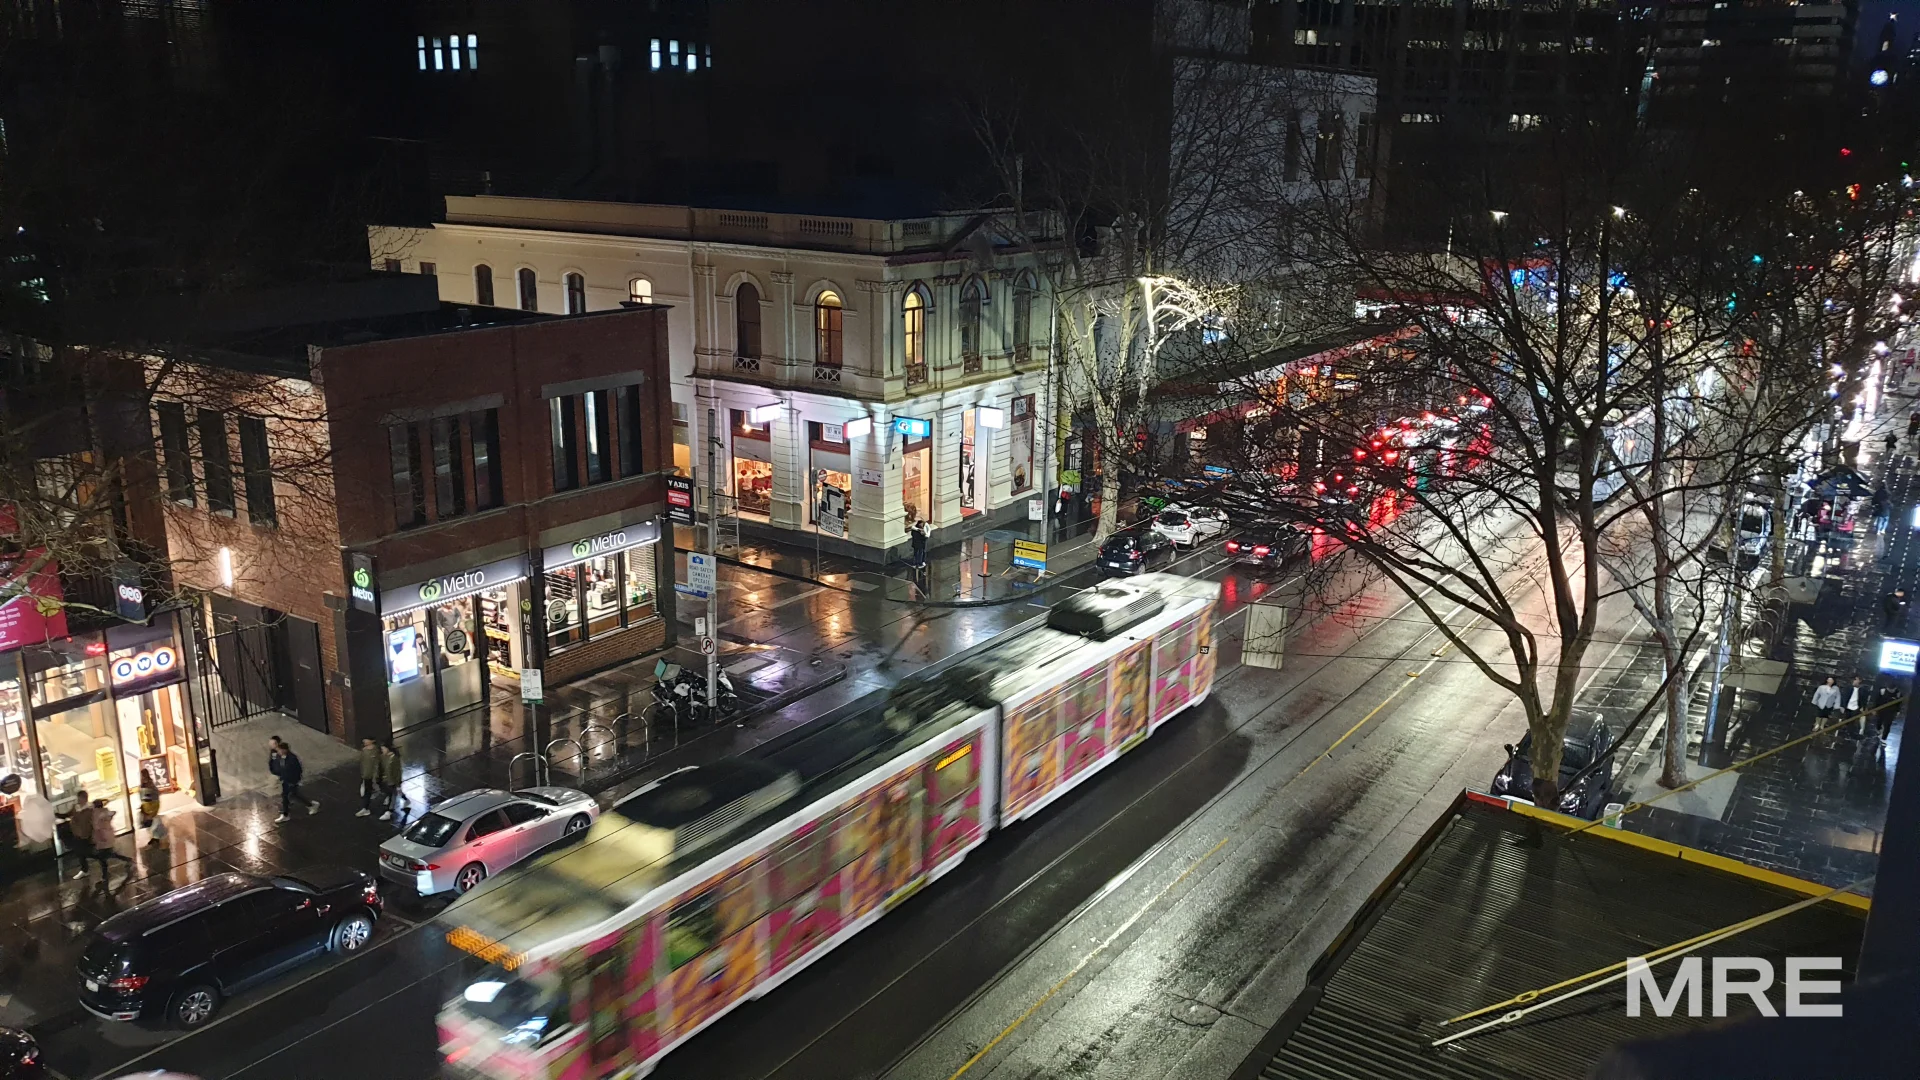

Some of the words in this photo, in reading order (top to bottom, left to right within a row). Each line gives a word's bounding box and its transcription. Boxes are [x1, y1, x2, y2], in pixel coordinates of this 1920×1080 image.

[673, 481, 689, 489] AXIS
[591, 530, 626, 553] Metro
[443, 570, 485, 595] Metro
[352, 586, 374, 602] Metro
[1200, 646, 1209, 654] 35
[116, 651, 172, 677] BWS
